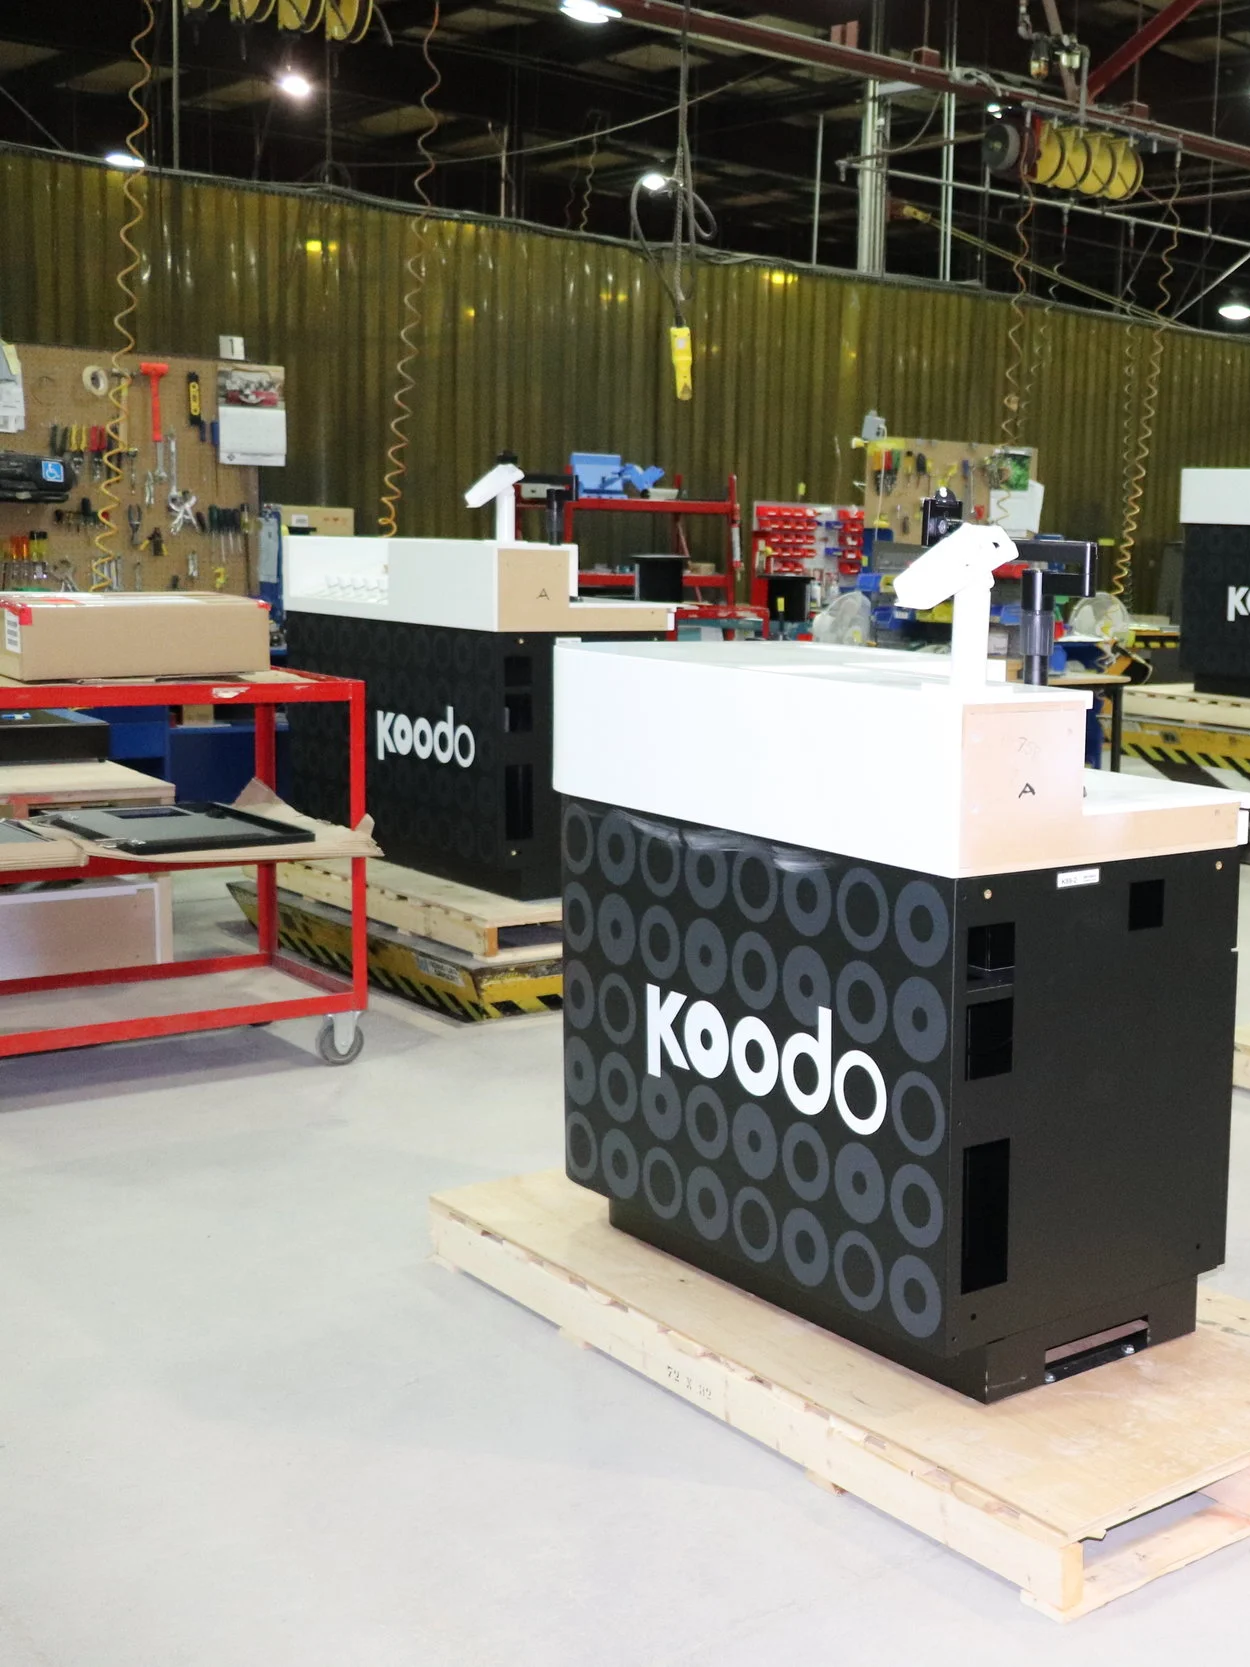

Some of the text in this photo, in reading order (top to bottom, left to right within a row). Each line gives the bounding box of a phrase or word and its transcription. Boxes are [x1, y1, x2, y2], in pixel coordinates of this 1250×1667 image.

[377, 705, 475, 768] Koodo
[1018, 782, 1036, 799] A
[646, 983, 888, 1136] Koodo
